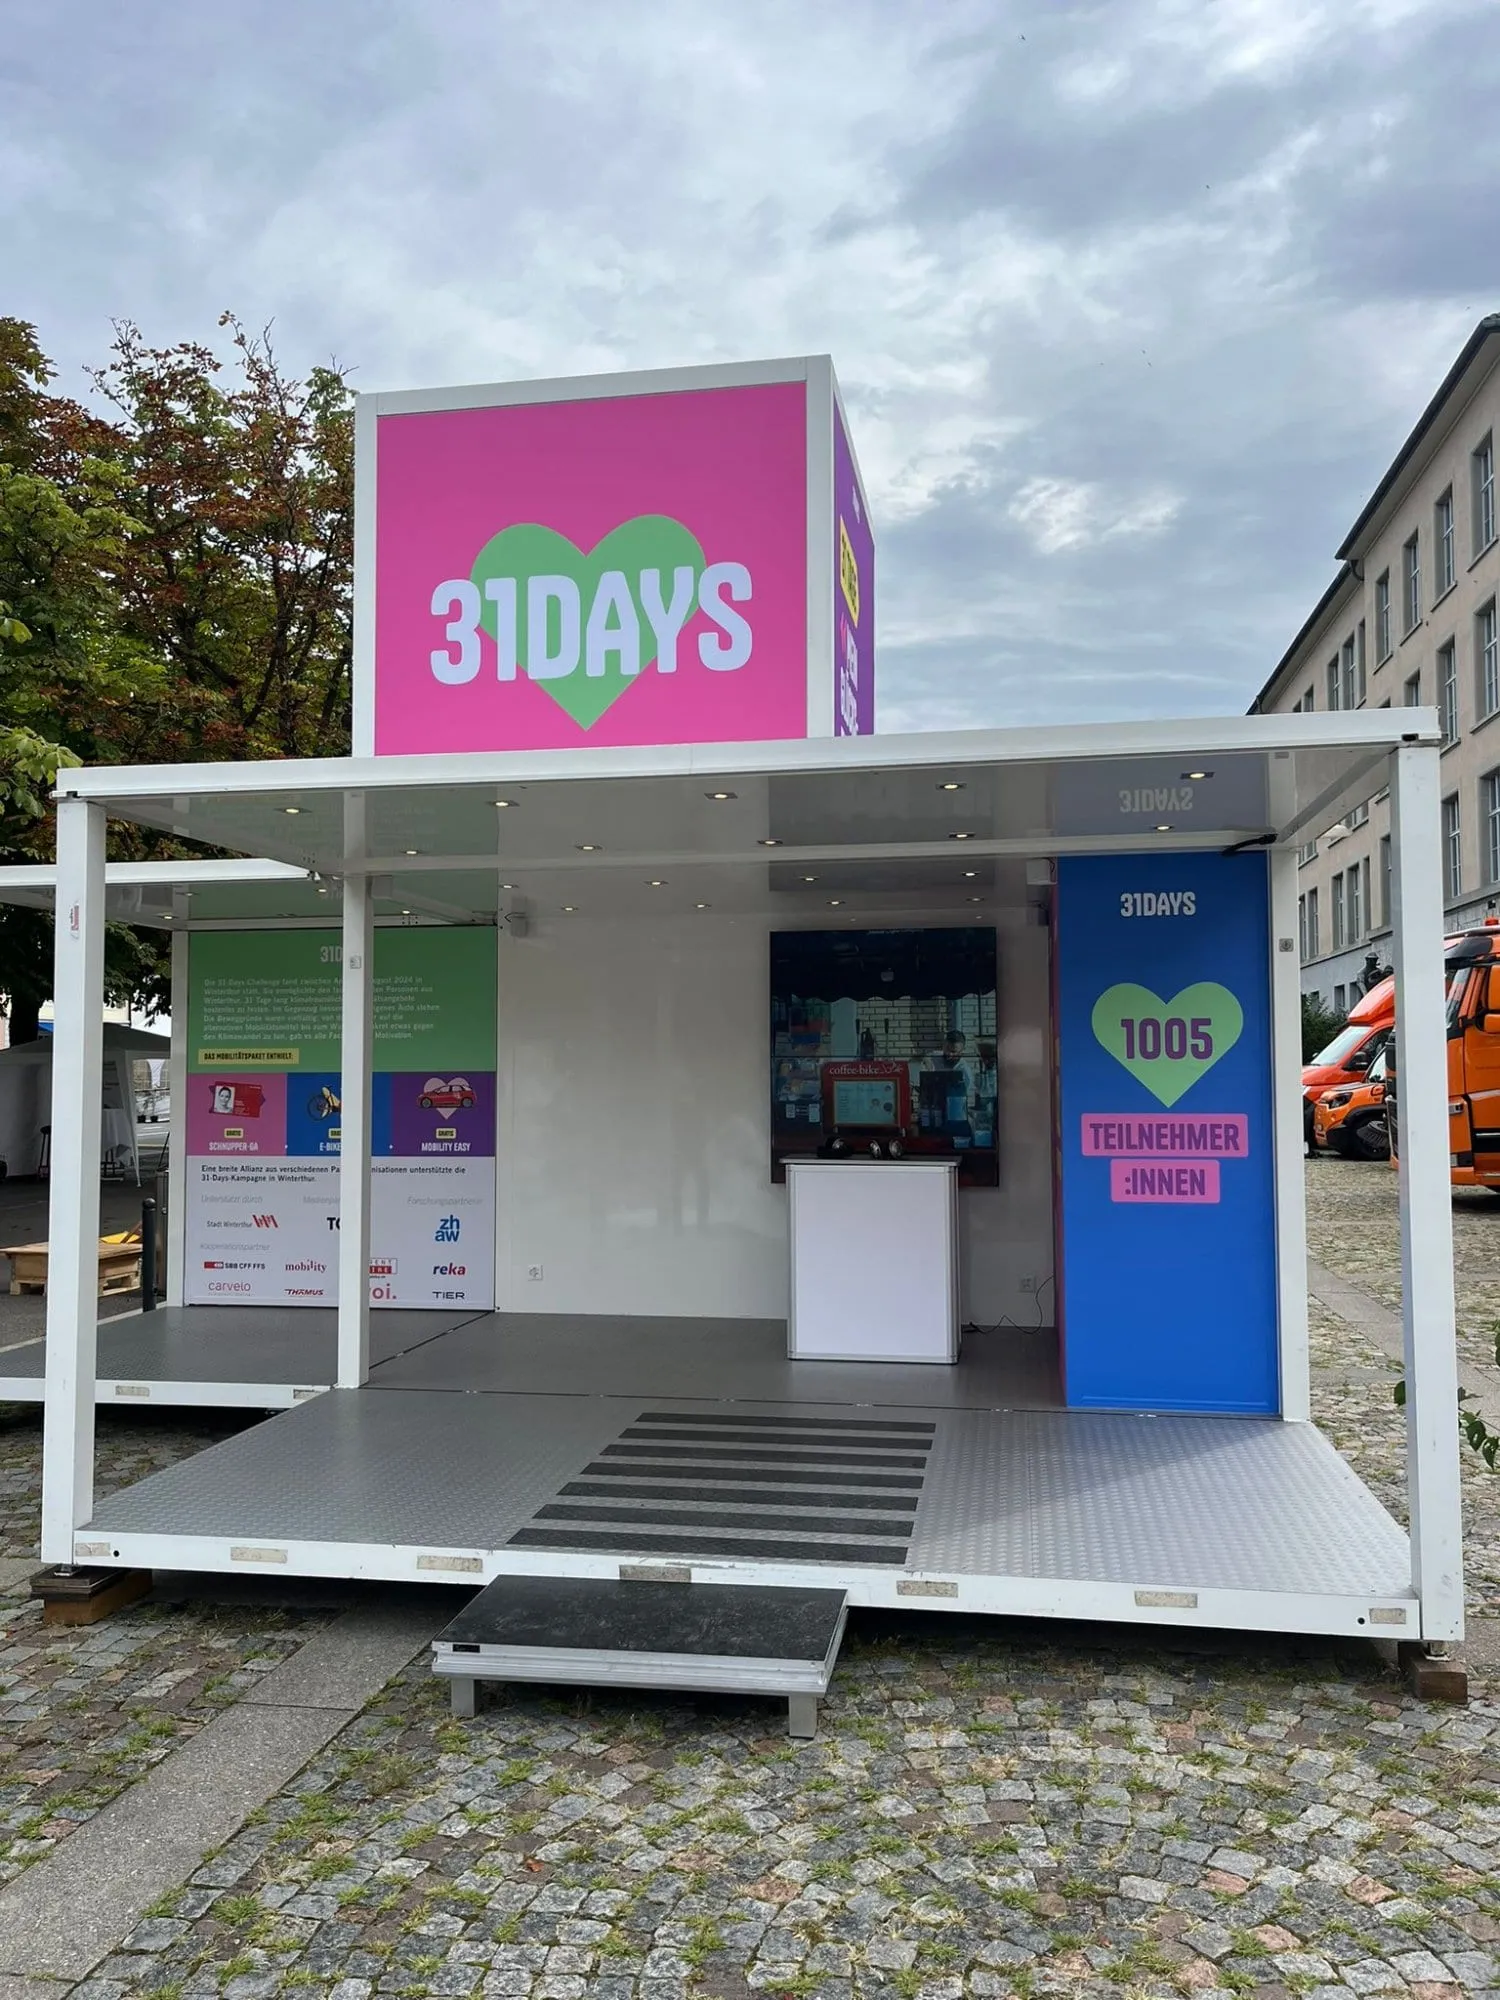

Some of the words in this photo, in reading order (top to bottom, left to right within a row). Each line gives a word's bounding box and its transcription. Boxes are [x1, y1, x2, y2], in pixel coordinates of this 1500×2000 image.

[430, 562, 753, 685] 31DAYS
[1120, 892, 1196, 917] 31DAYS
[1121, 1018, 1213, 1060] 1005
[204, 1052, 215, 1060] DAS
[1089, 1123, 1240, 1150] TEILNEHMER
[208, 1142, 259, 1152] SCHNUPPER-GA
[421, 1142, 453, 1152] MOBILITY
[454, 1142, 471, 1151] EASY
[279, 1165, 329, 1173] verschiedenen
[409, 1165, 453, 1174] unterstützte
[454, 1166, 466, 1174] die
[1124, 1168, 1206, 1195] :INNEN
[285, 1260, 327, 1274] mobility
[432, 1262, 466, 1275] reka
[208, 1281, 251, 1291] carvelo
[432, 1291, 466, 1300] TIER
